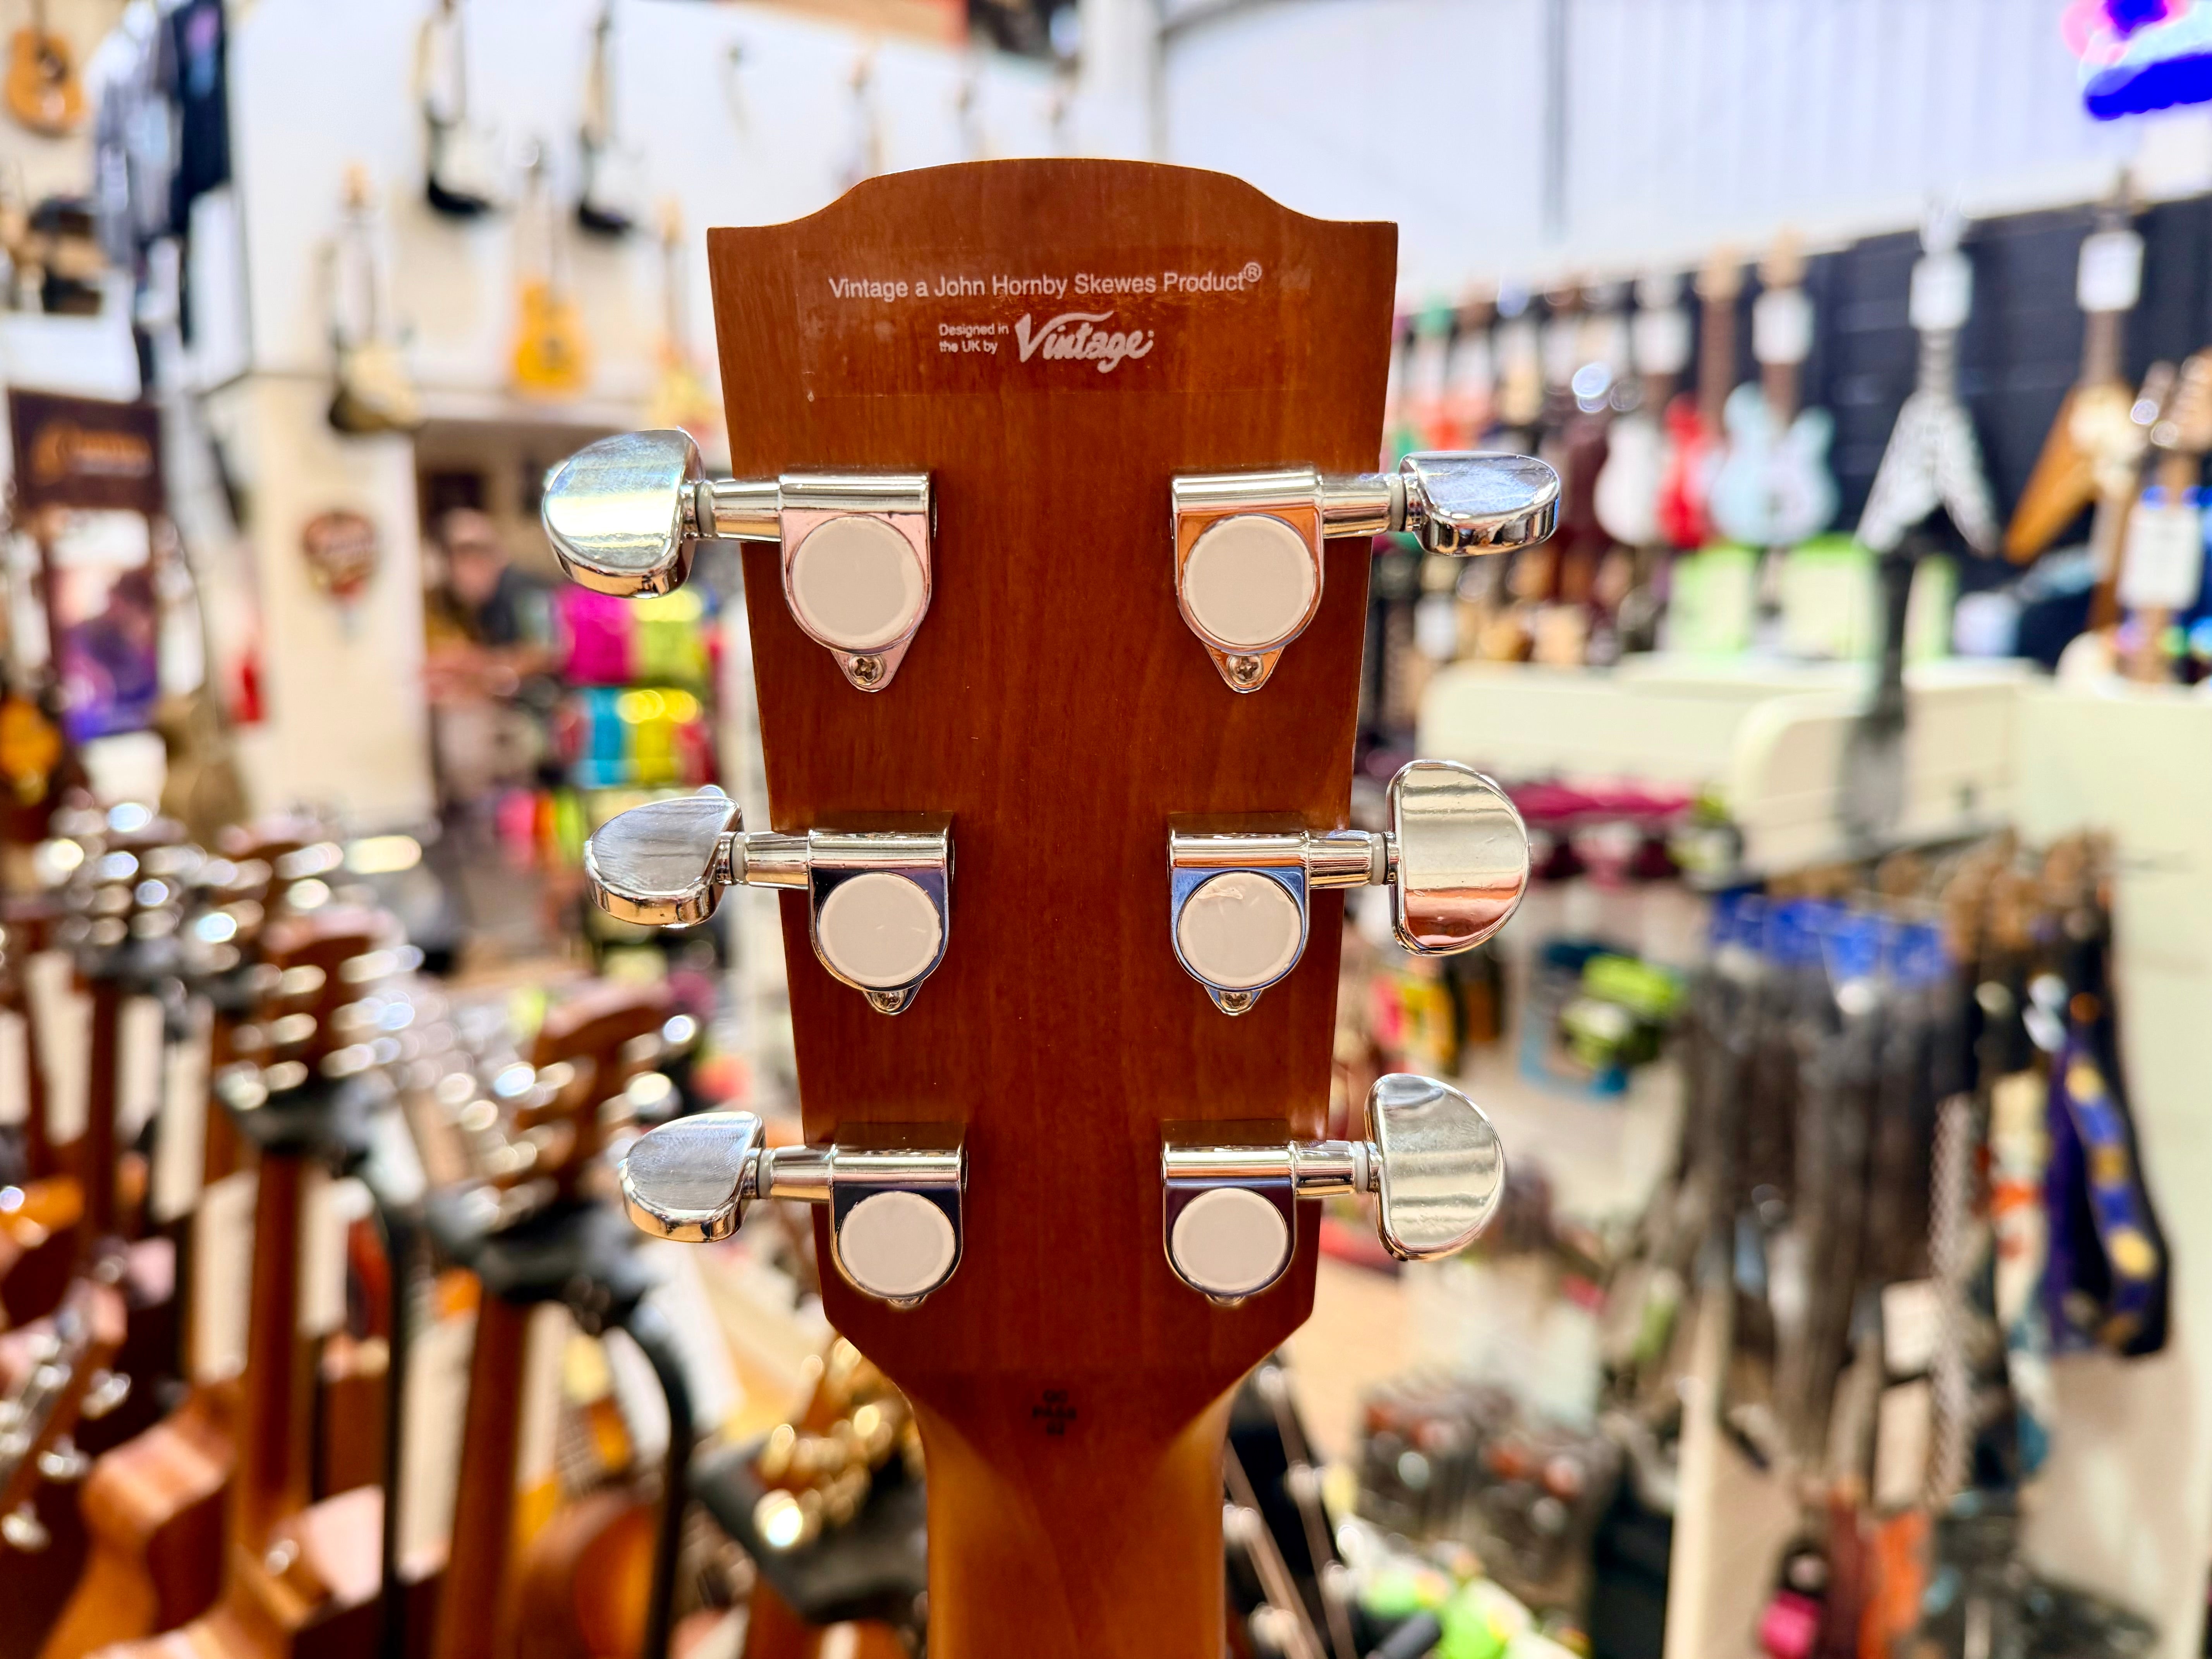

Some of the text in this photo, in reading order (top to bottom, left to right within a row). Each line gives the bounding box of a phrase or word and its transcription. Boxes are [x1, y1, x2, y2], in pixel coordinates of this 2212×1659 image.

[828, 277, 908, 302] Vintage
[915, 280, 929, 297] a
[934, 275, 985, 297] John
[992, 273, 1068, 300] Hornby
[1075, 273, 1156, 294] Skewes
[939, 322, 1009, 338] Designed in
[939, 340, 998, 355] the UK by
[1015, 310, 1154, 374] Vintage
